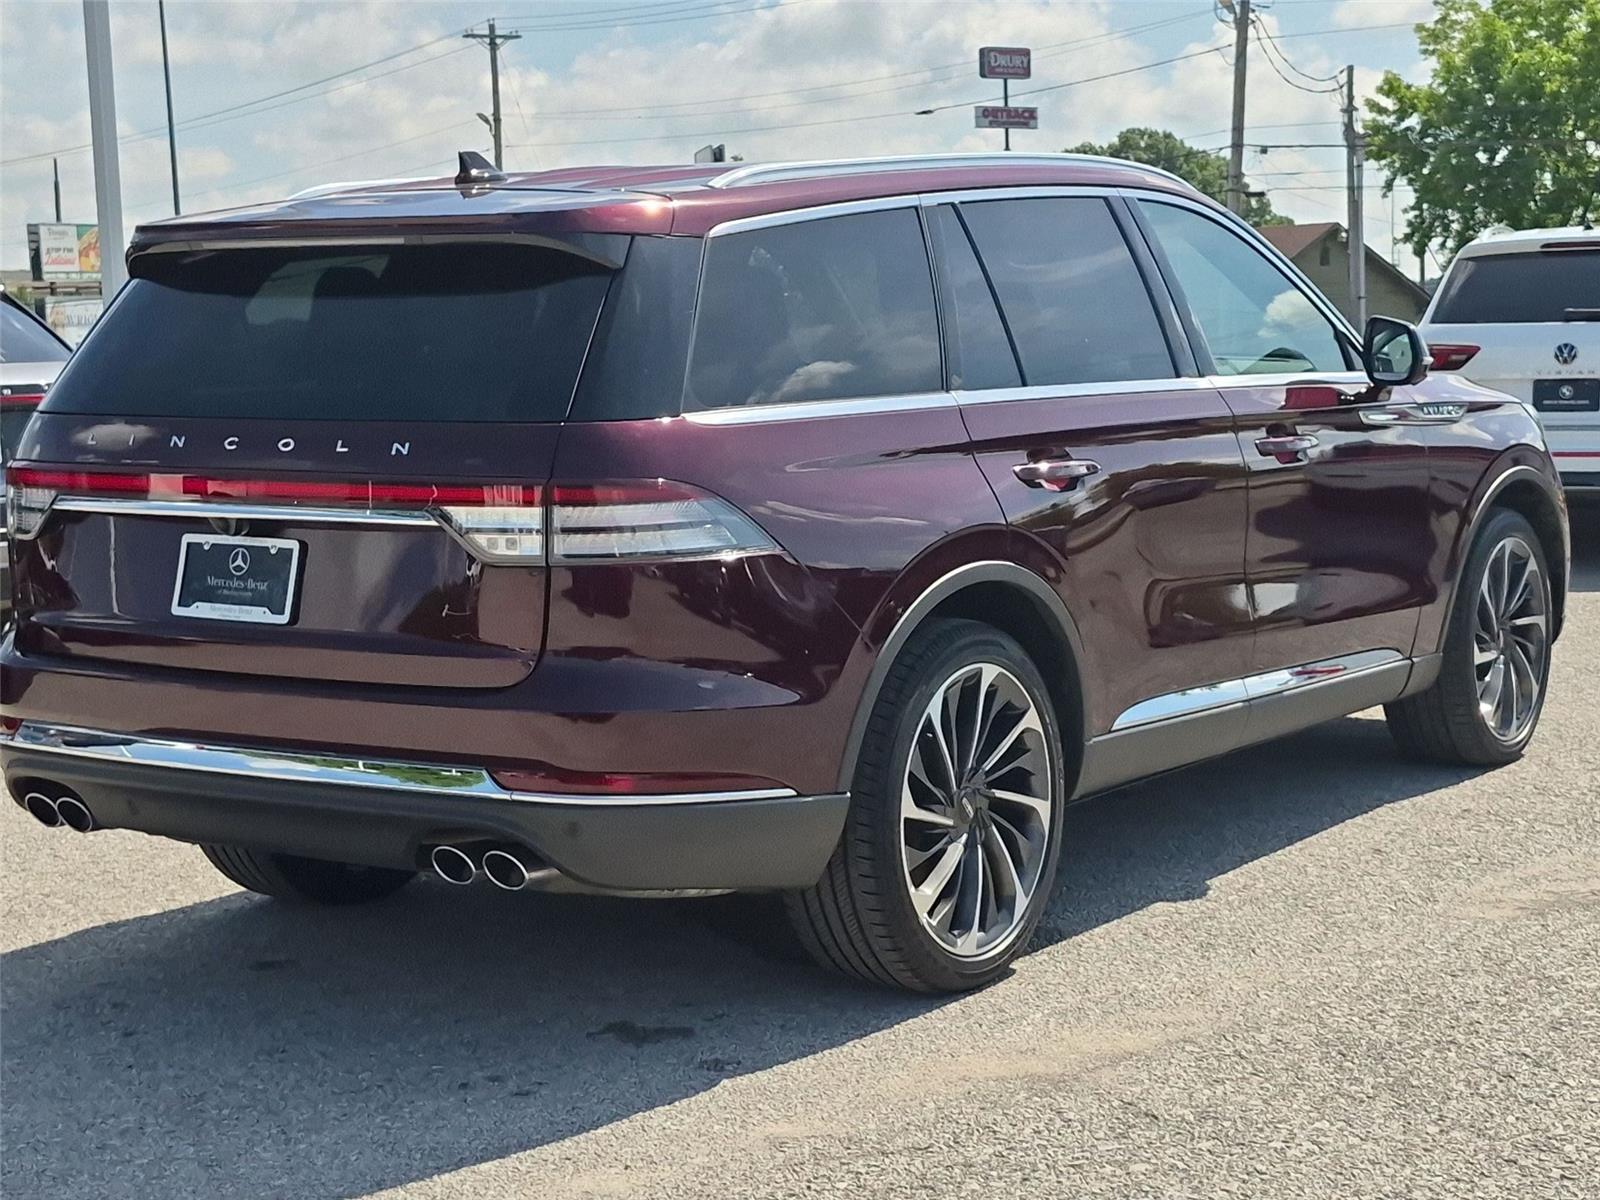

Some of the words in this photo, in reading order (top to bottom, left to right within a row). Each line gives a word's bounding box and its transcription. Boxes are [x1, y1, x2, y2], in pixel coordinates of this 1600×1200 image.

[991, 51, 1029, 68] DRURY
[87, 432, 411, 456] LINCOLN
[207, 575, 269, 591] Mercedes-Benz
